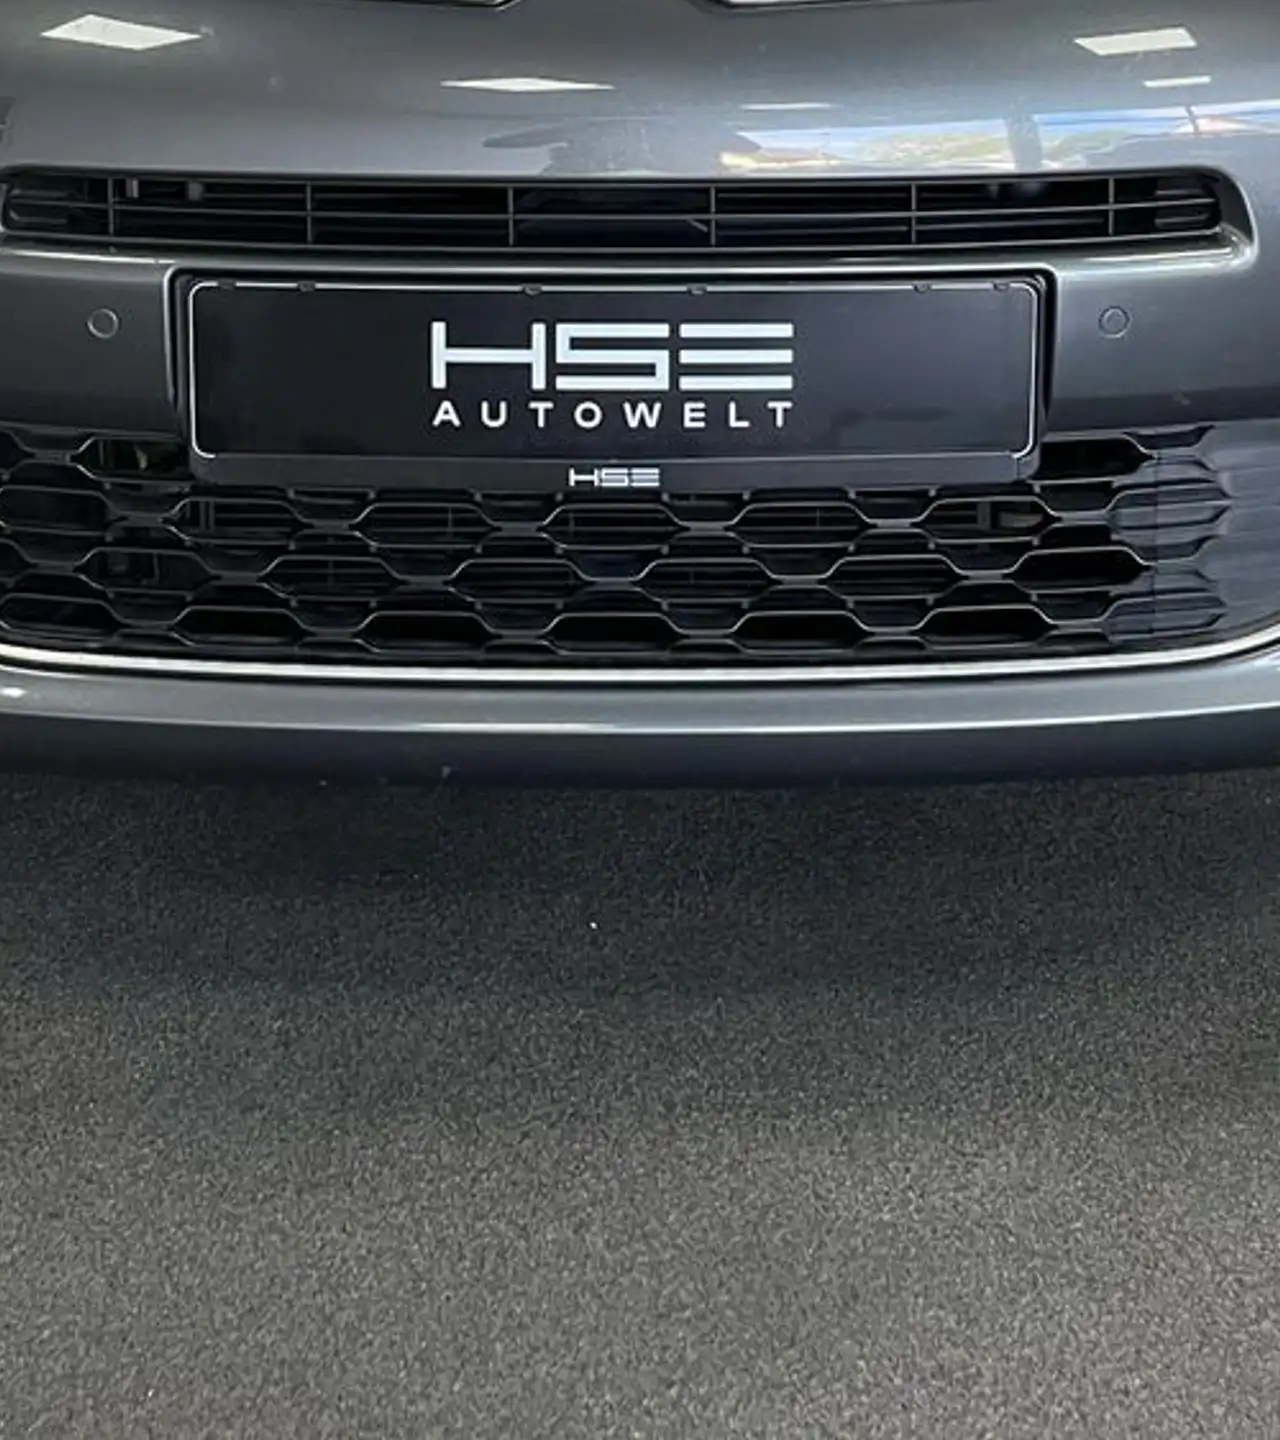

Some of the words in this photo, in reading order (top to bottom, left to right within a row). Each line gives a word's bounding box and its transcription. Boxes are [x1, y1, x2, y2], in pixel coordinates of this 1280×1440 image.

[431, 321, 794, 391] HSE
[432, 400, 793, 429] AUTOWELT
[568, 467, 660, 487] HSE
